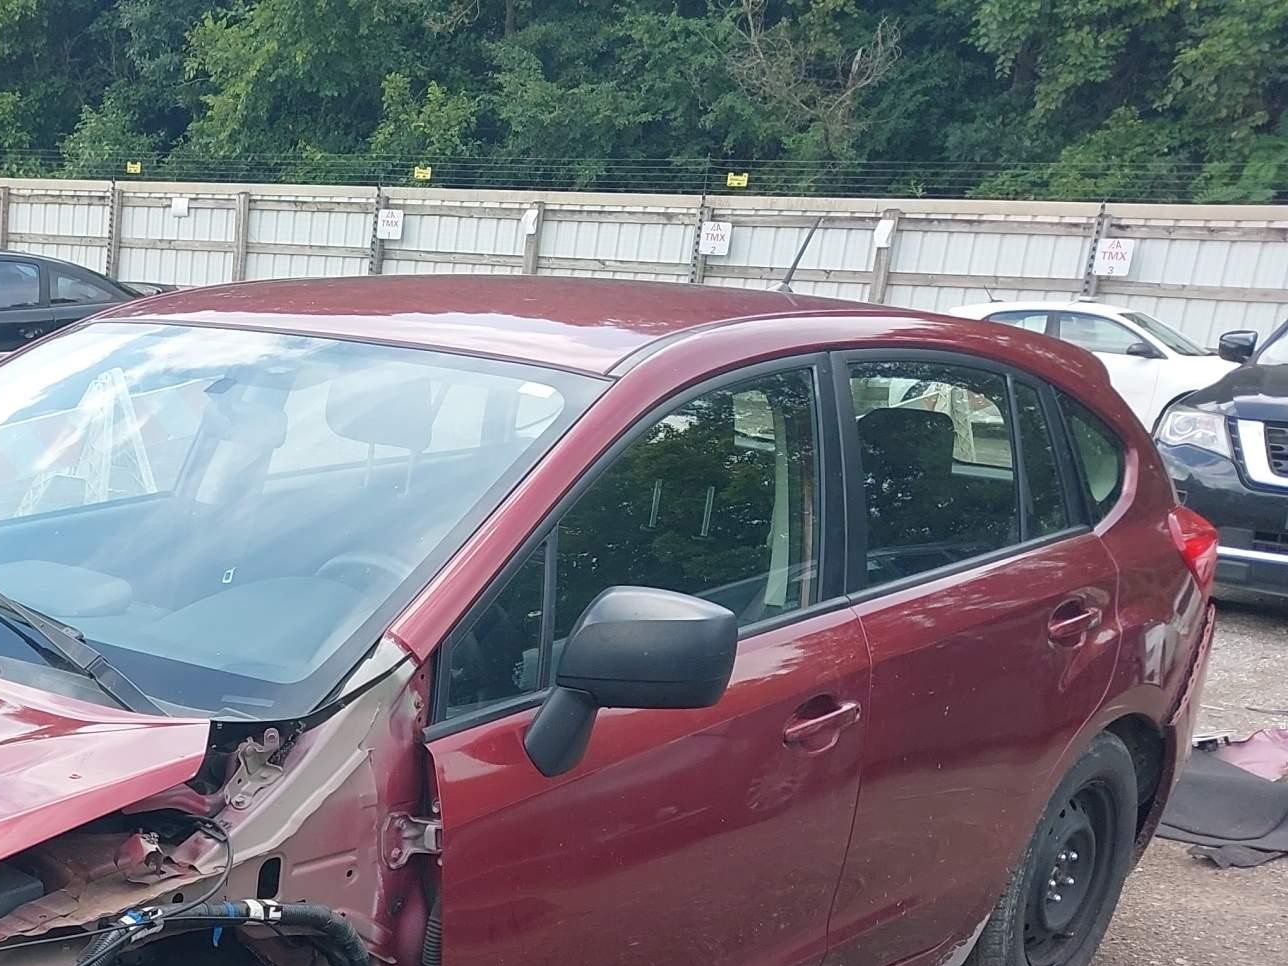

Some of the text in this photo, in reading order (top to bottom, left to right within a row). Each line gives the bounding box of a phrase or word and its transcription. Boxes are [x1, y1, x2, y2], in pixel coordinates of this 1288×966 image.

[705, 233, 726, 242] TMX
[710, 246, 717, 254] 2
[1102, 250, 1128, 261] TMX
[1107, 266, 1114, 275] 3
